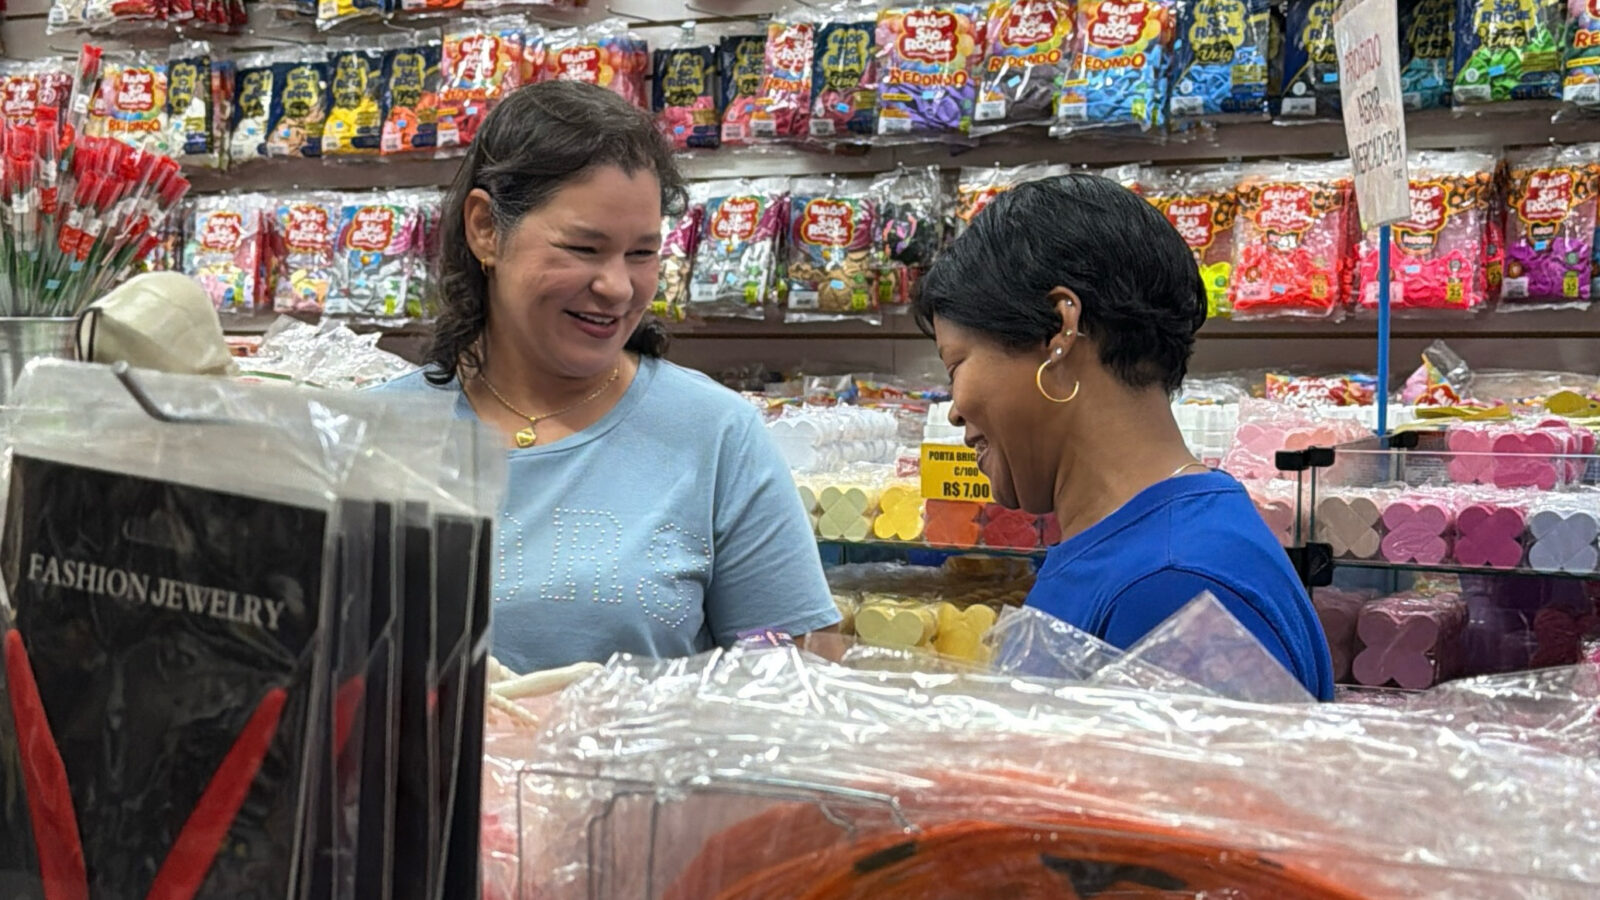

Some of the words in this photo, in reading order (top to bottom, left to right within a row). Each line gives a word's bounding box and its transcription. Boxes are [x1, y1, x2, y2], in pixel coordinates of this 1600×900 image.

[890, 69, 968, 86] REDONDO
[1411, 209, 1441, 225] OQUE
[929, 451, 955, 461] PORTA
[956, 452, 977, 462] BRIG
[954, 466, 978, 477] C/100
[943, 481, 960, 497] R$
[962, 482, 990, 498] 7,00
[28, 553, 150, 602] FASHION
[151, 577, 285, 631] JEWELRY
